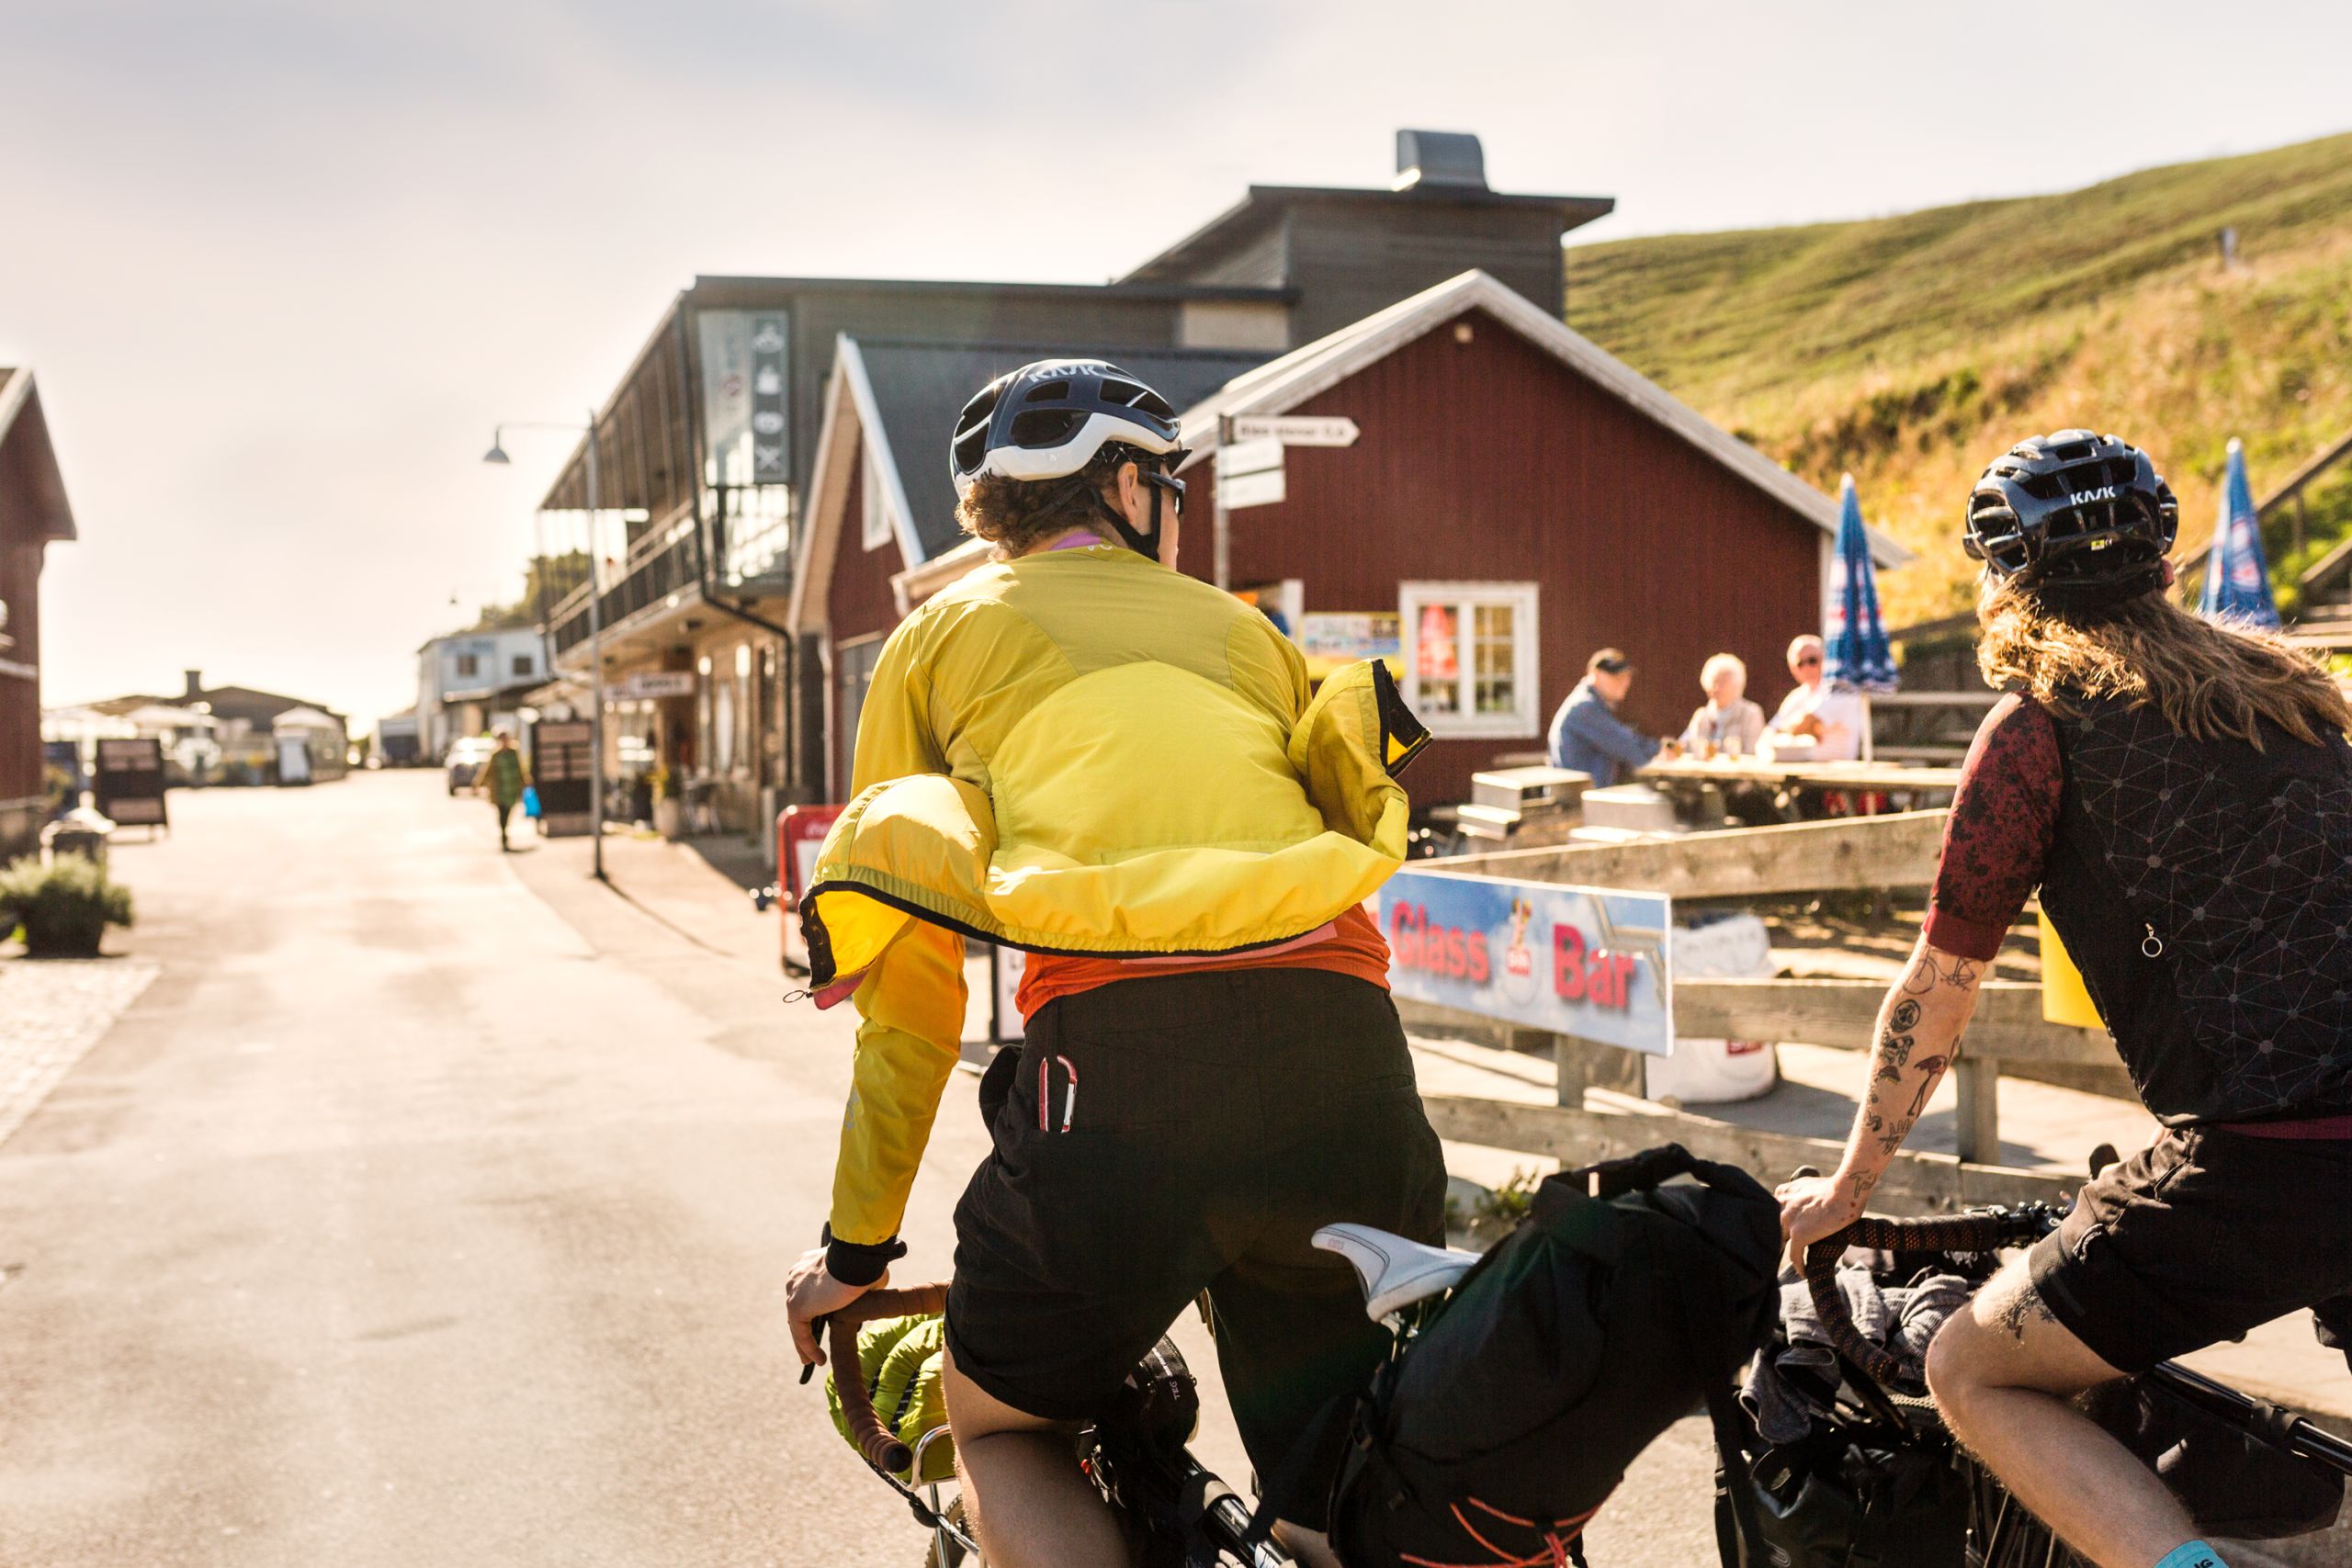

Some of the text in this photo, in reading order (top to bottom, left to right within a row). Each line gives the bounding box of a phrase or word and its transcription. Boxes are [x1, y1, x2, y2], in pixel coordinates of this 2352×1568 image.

[1028, 365, 1099, 382] KASK
[2070, 485, 2117, 506] KASK
[1390, 899, 1635, 1009] Glass Bar
